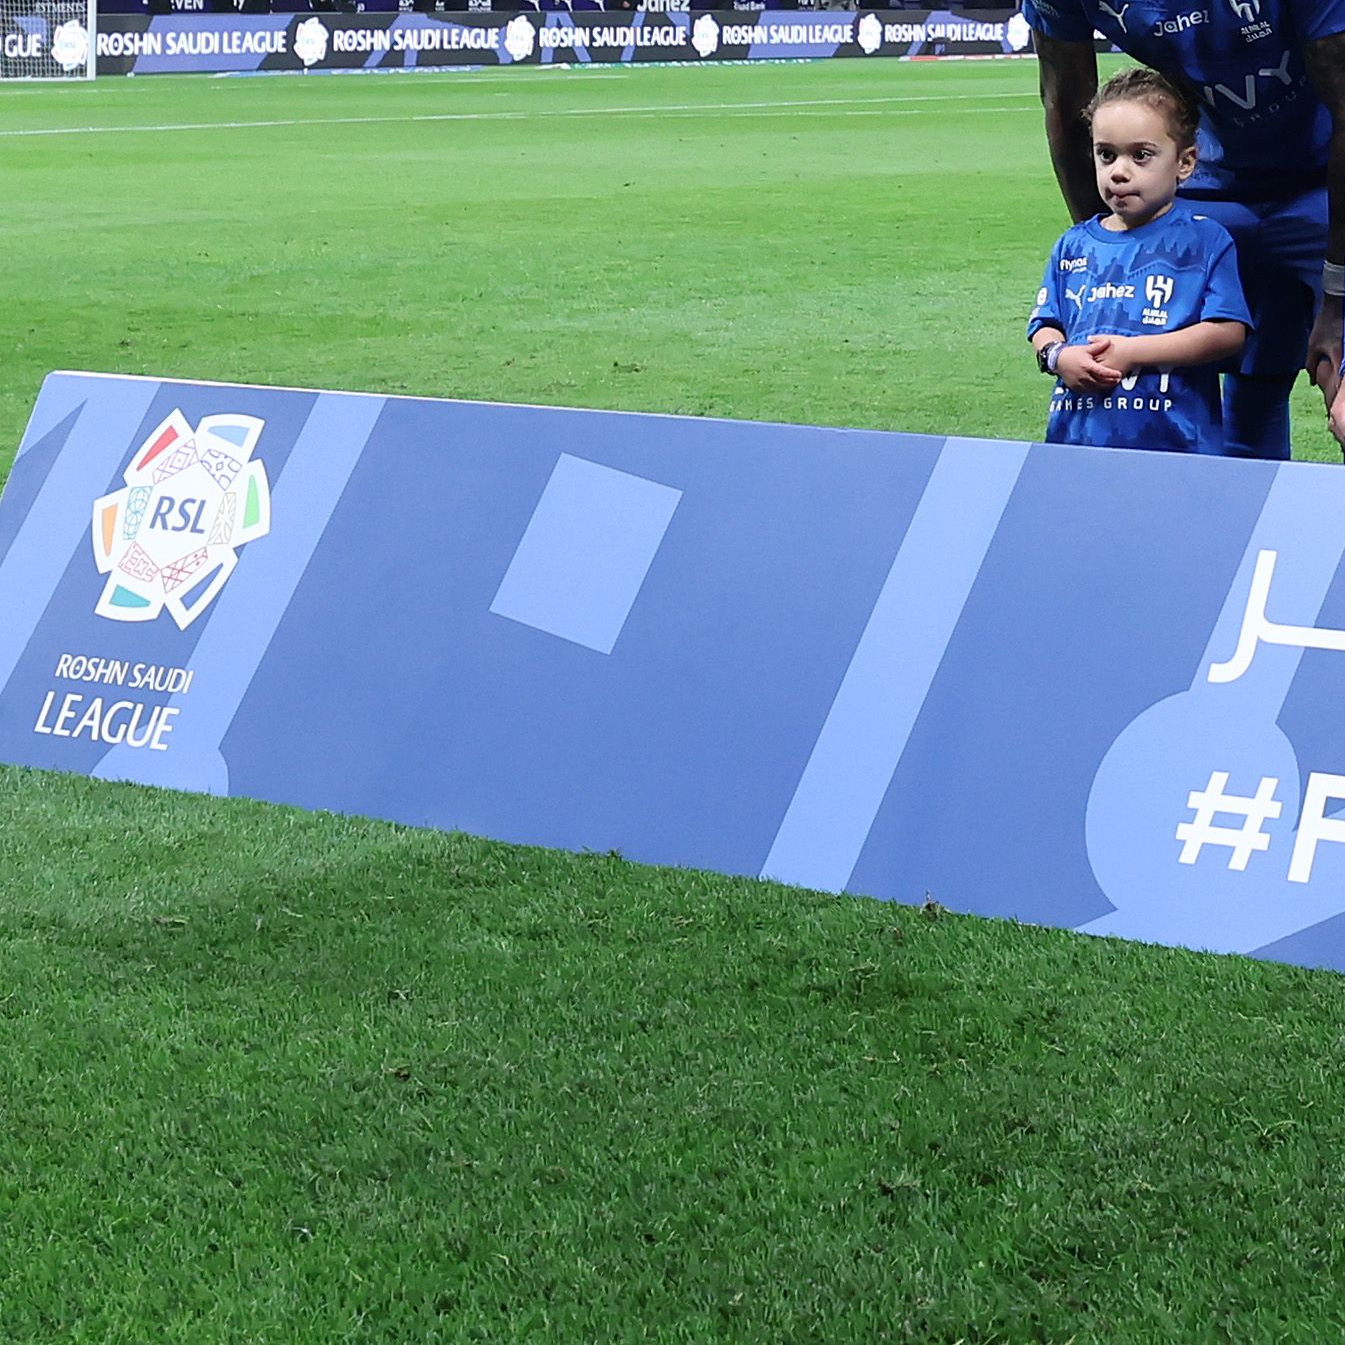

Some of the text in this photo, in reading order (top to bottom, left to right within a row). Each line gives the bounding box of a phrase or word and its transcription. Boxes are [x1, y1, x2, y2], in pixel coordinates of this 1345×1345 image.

[97, 31, 287, 55] ROSHN SAUDI LEAGUE
[333, 27, 499, 52] ROSHN SAUDI LEAGUE
[539, 26, 687, 48] ROSHN SAUDI LEAGUE
[722, 24, 853, 45] ROSHN SAUDI LEAGUE
[885, 23, 926, 42] ROSHN
[962, 23, 1004, 41] LEAGUE
[4, 34, 42, 57] GUE
[1103, 397, 1172, 412] GROUP
[149, 495, 207, 535] RSL
[55, 653, 195, 695] ROSHN SAUDI
[34, 690, 180, 751] LEAGUE
